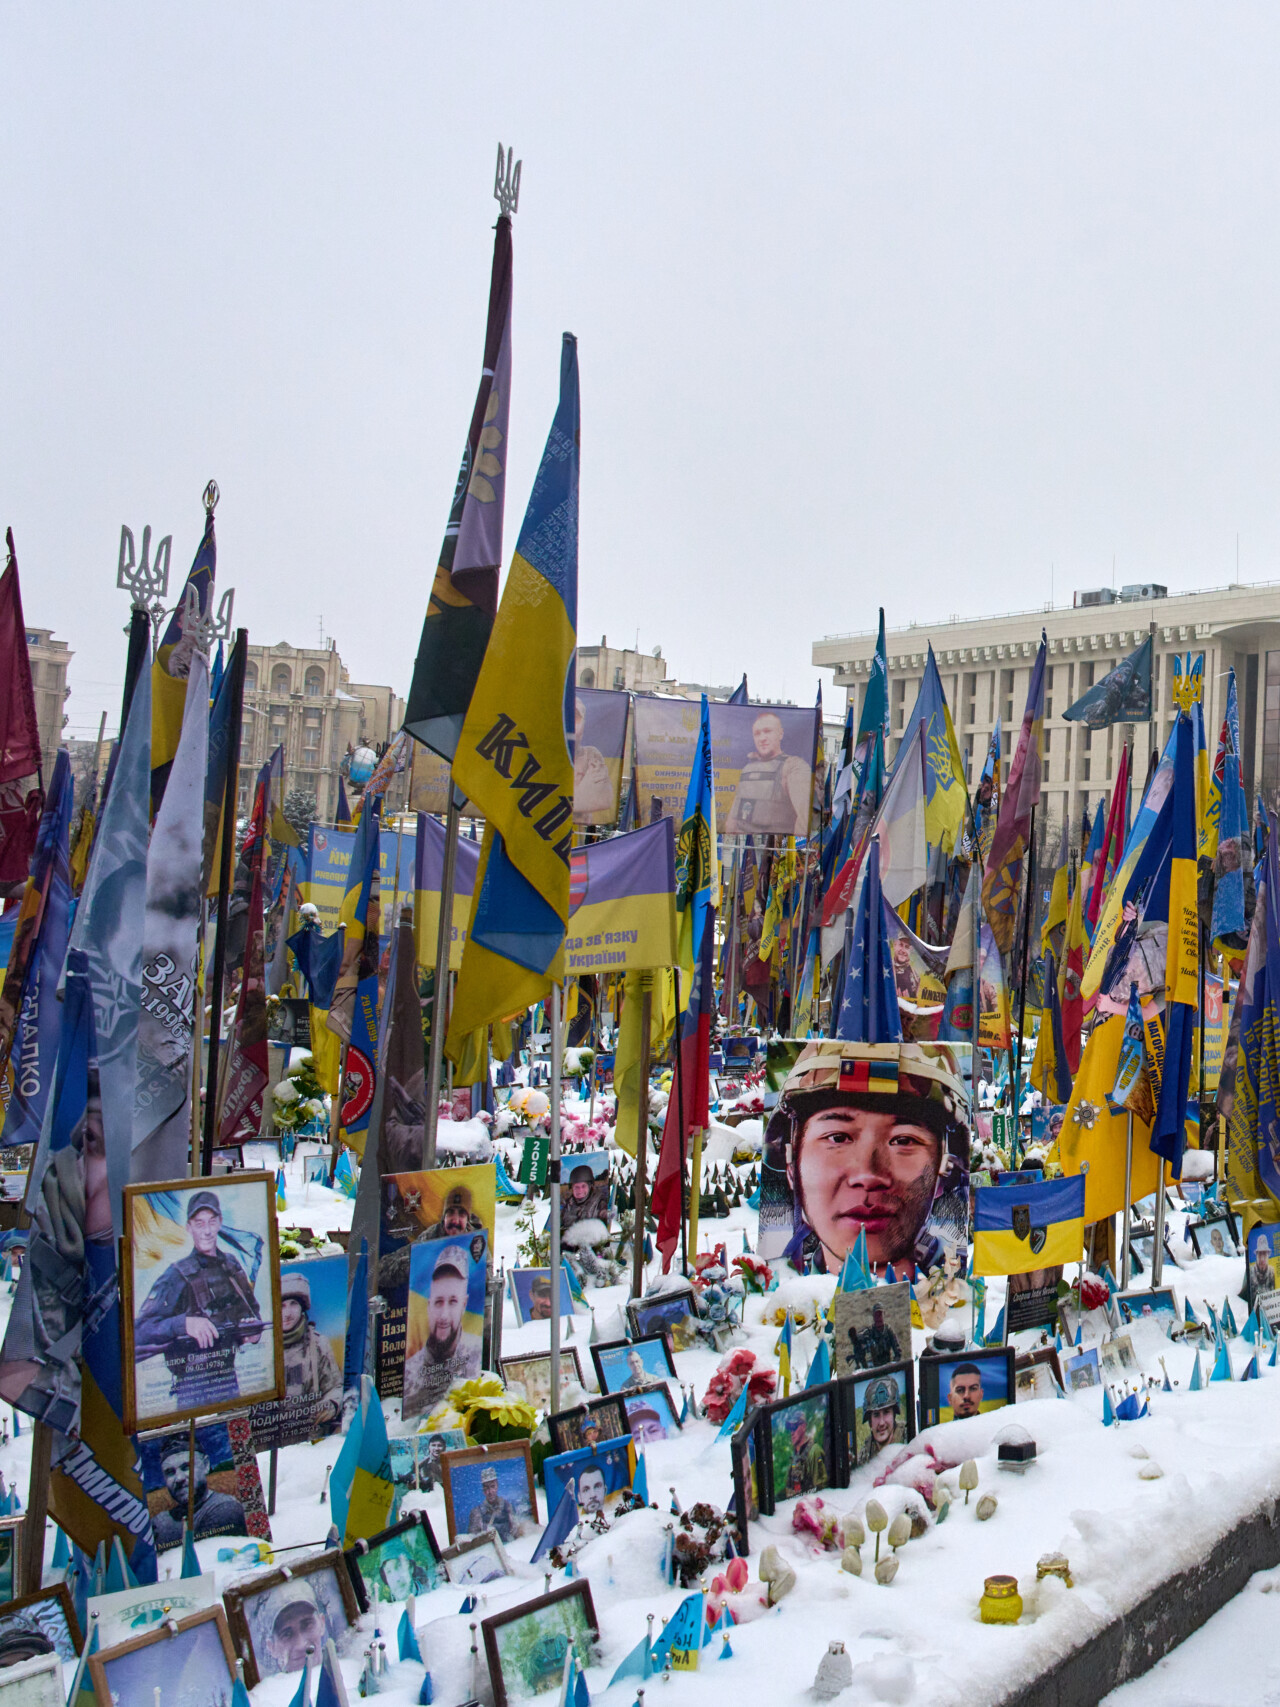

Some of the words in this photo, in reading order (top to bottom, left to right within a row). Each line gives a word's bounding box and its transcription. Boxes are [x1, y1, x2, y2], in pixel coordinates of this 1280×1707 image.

[585, 929, 638, 949] зв'язку
[569, 951, 627, 968] України
[529, 1140, 541, 1181] 2025
[248, 1400, 280, 1417] учак
[283, 1390, 323, 1408] Роман
[249, 1401, 332, 1428] лодимирович
[157, 1538, 183, 1551] Микол
